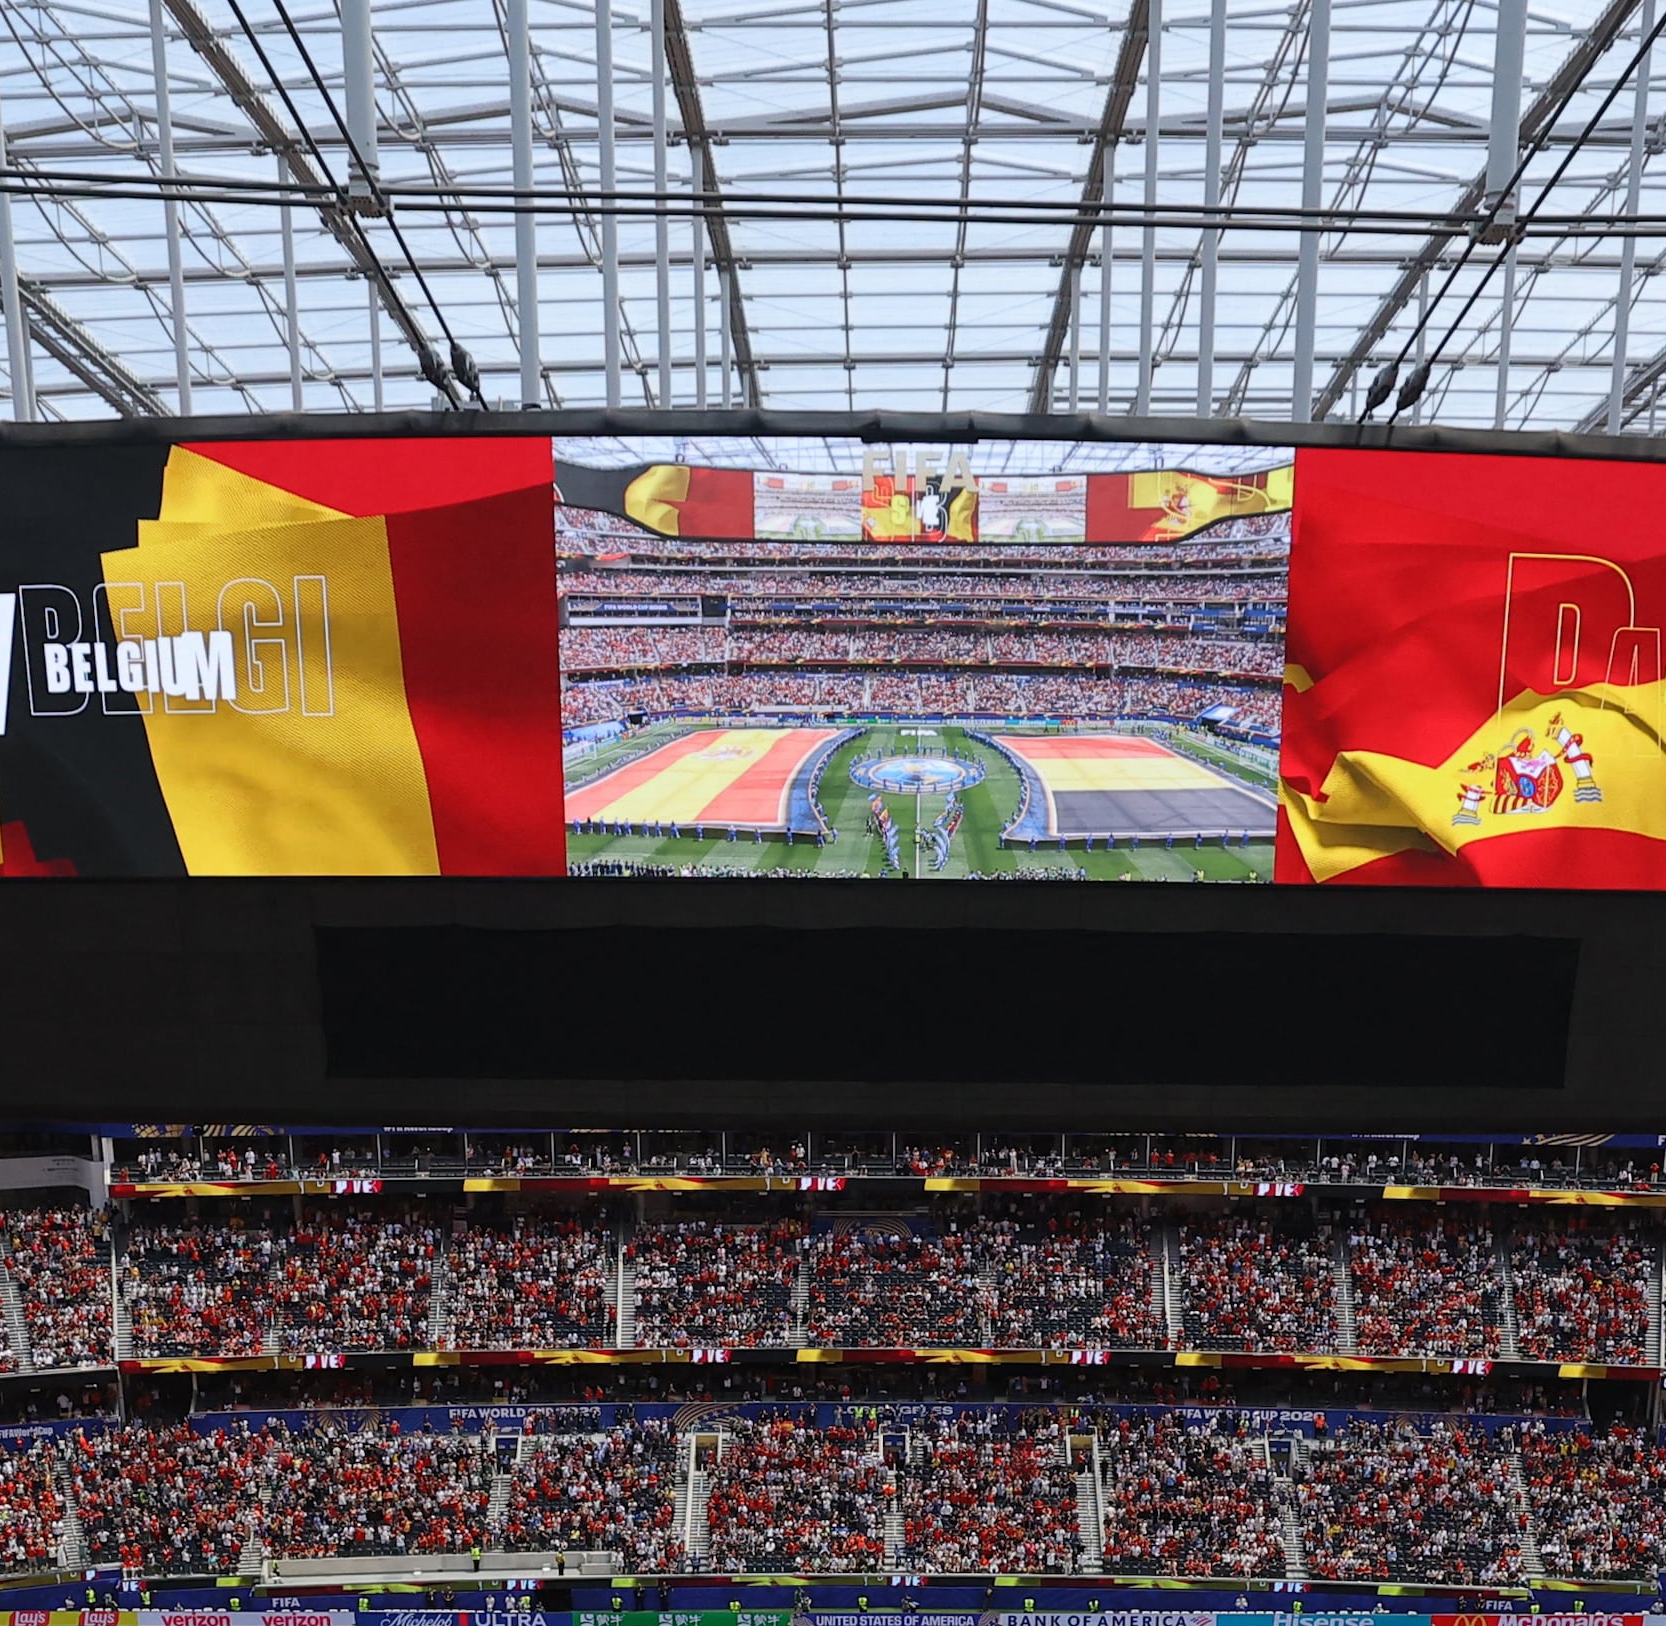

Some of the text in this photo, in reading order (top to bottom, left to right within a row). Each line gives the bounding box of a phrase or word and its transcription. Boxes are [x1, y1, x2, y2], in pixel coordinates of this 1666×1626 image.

[862, 450, 979, 493] FIFA
[44, 629, 236, 700] BELGIUM
[449, 1407, 478, 1420] FIFA
[479, 1407, 527, 1419] WORLD
[1204, 1409, 1251, 1420] WORD
[273, 1598, 301, 1609] FIFA
[1486, 1600, 1513, 1611] FIFA
[161, 1612, 231, 1626] verizon
[816, 1615, 975, 1626] UNITED STATES OF AMERICA
